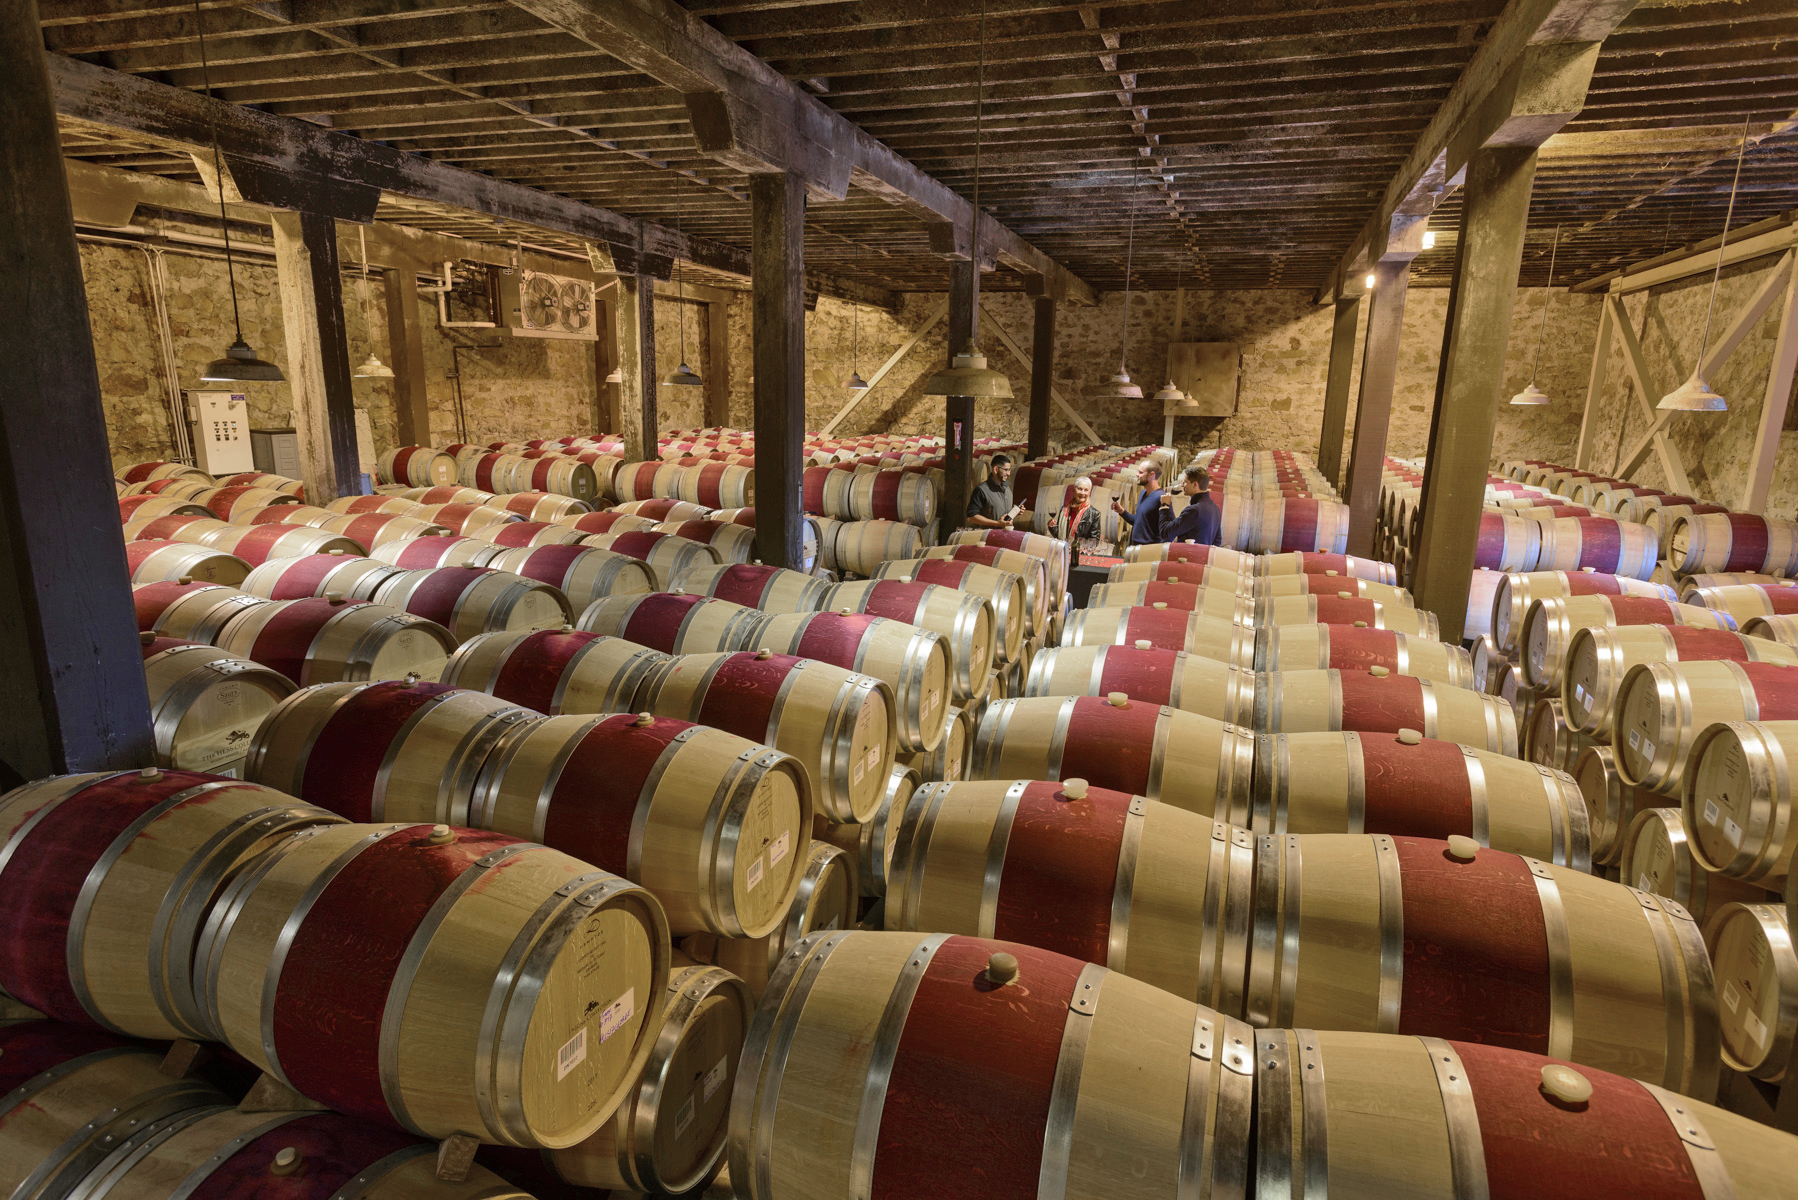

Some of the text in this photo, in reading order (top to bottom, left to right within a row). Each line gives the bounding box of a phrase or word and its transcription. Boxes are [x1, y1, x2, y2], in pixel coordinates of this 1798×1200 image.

[202, 740, 251, 761] THE HESS COLL
